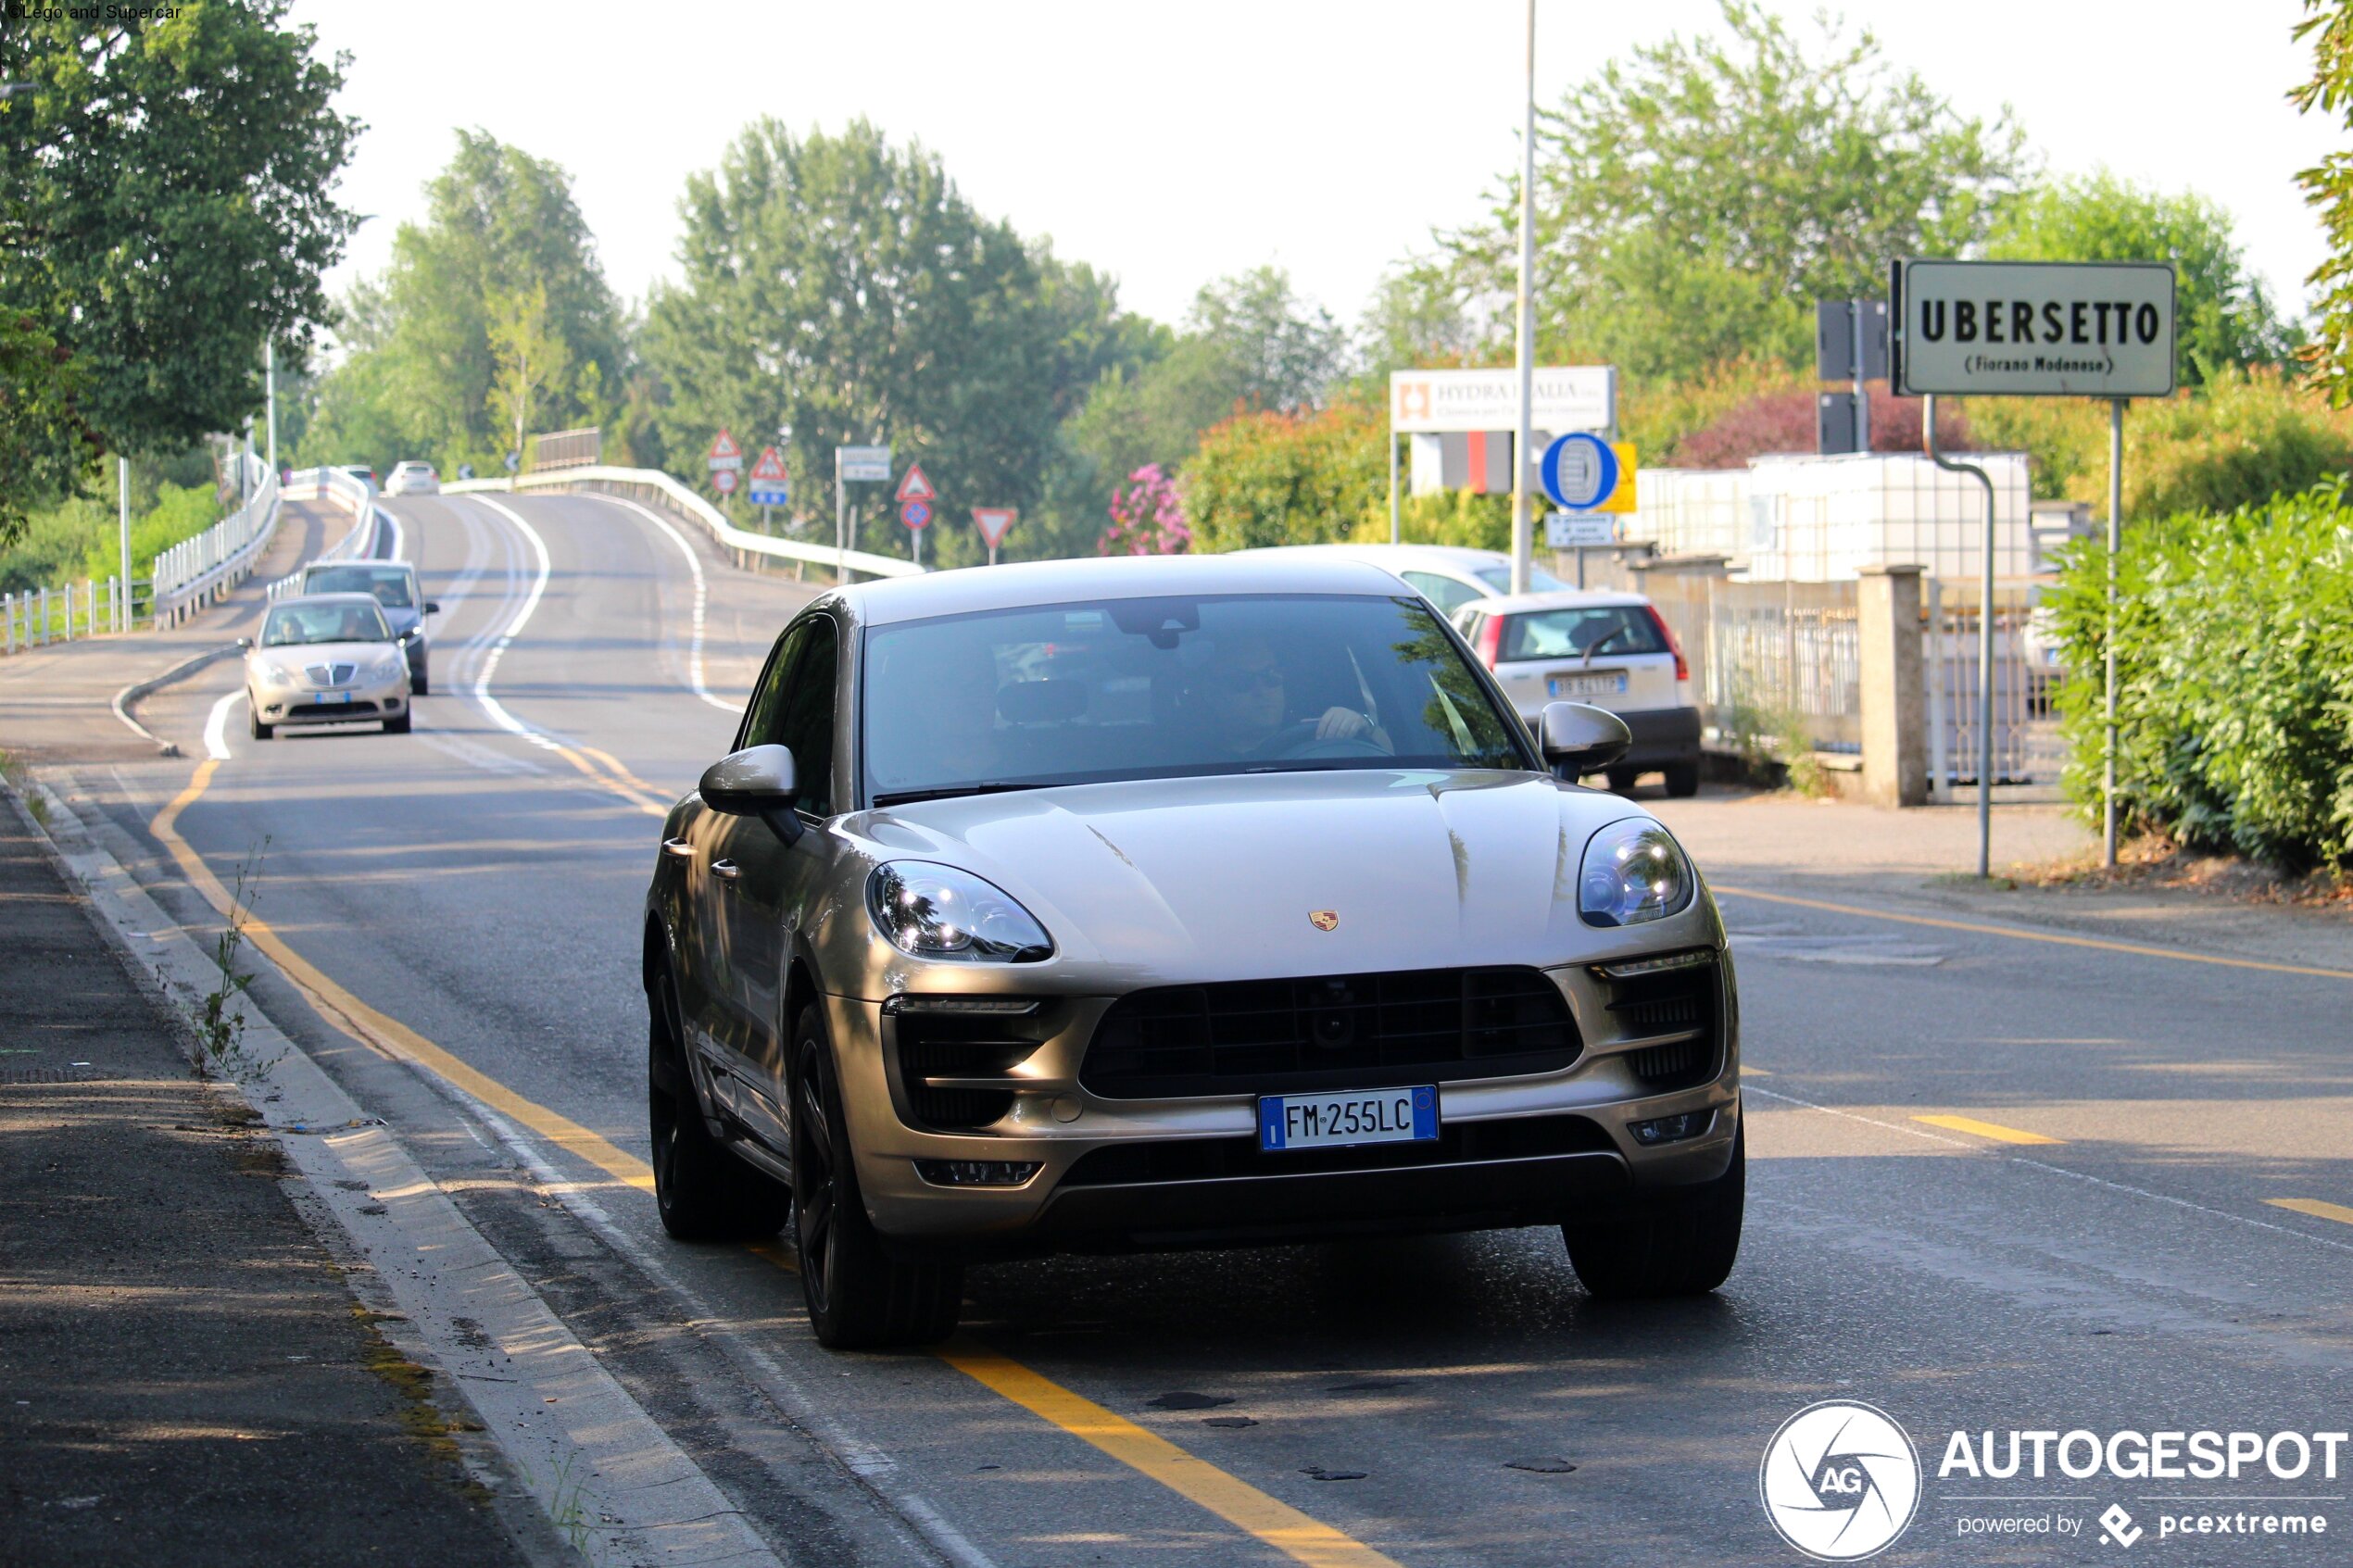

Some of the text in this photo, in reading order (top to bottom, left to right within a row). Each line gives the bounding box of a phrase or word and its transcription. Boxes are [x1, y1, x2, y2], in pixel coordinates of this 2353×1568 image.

[1921, 299, 2159, 345] UBERSETTO
[1964, 355, 2114, 375] (Fiorano Modenese)
[1438, 383, 1508, 401] HYDRA
[1513, 381, 1579, 399] IALIA
